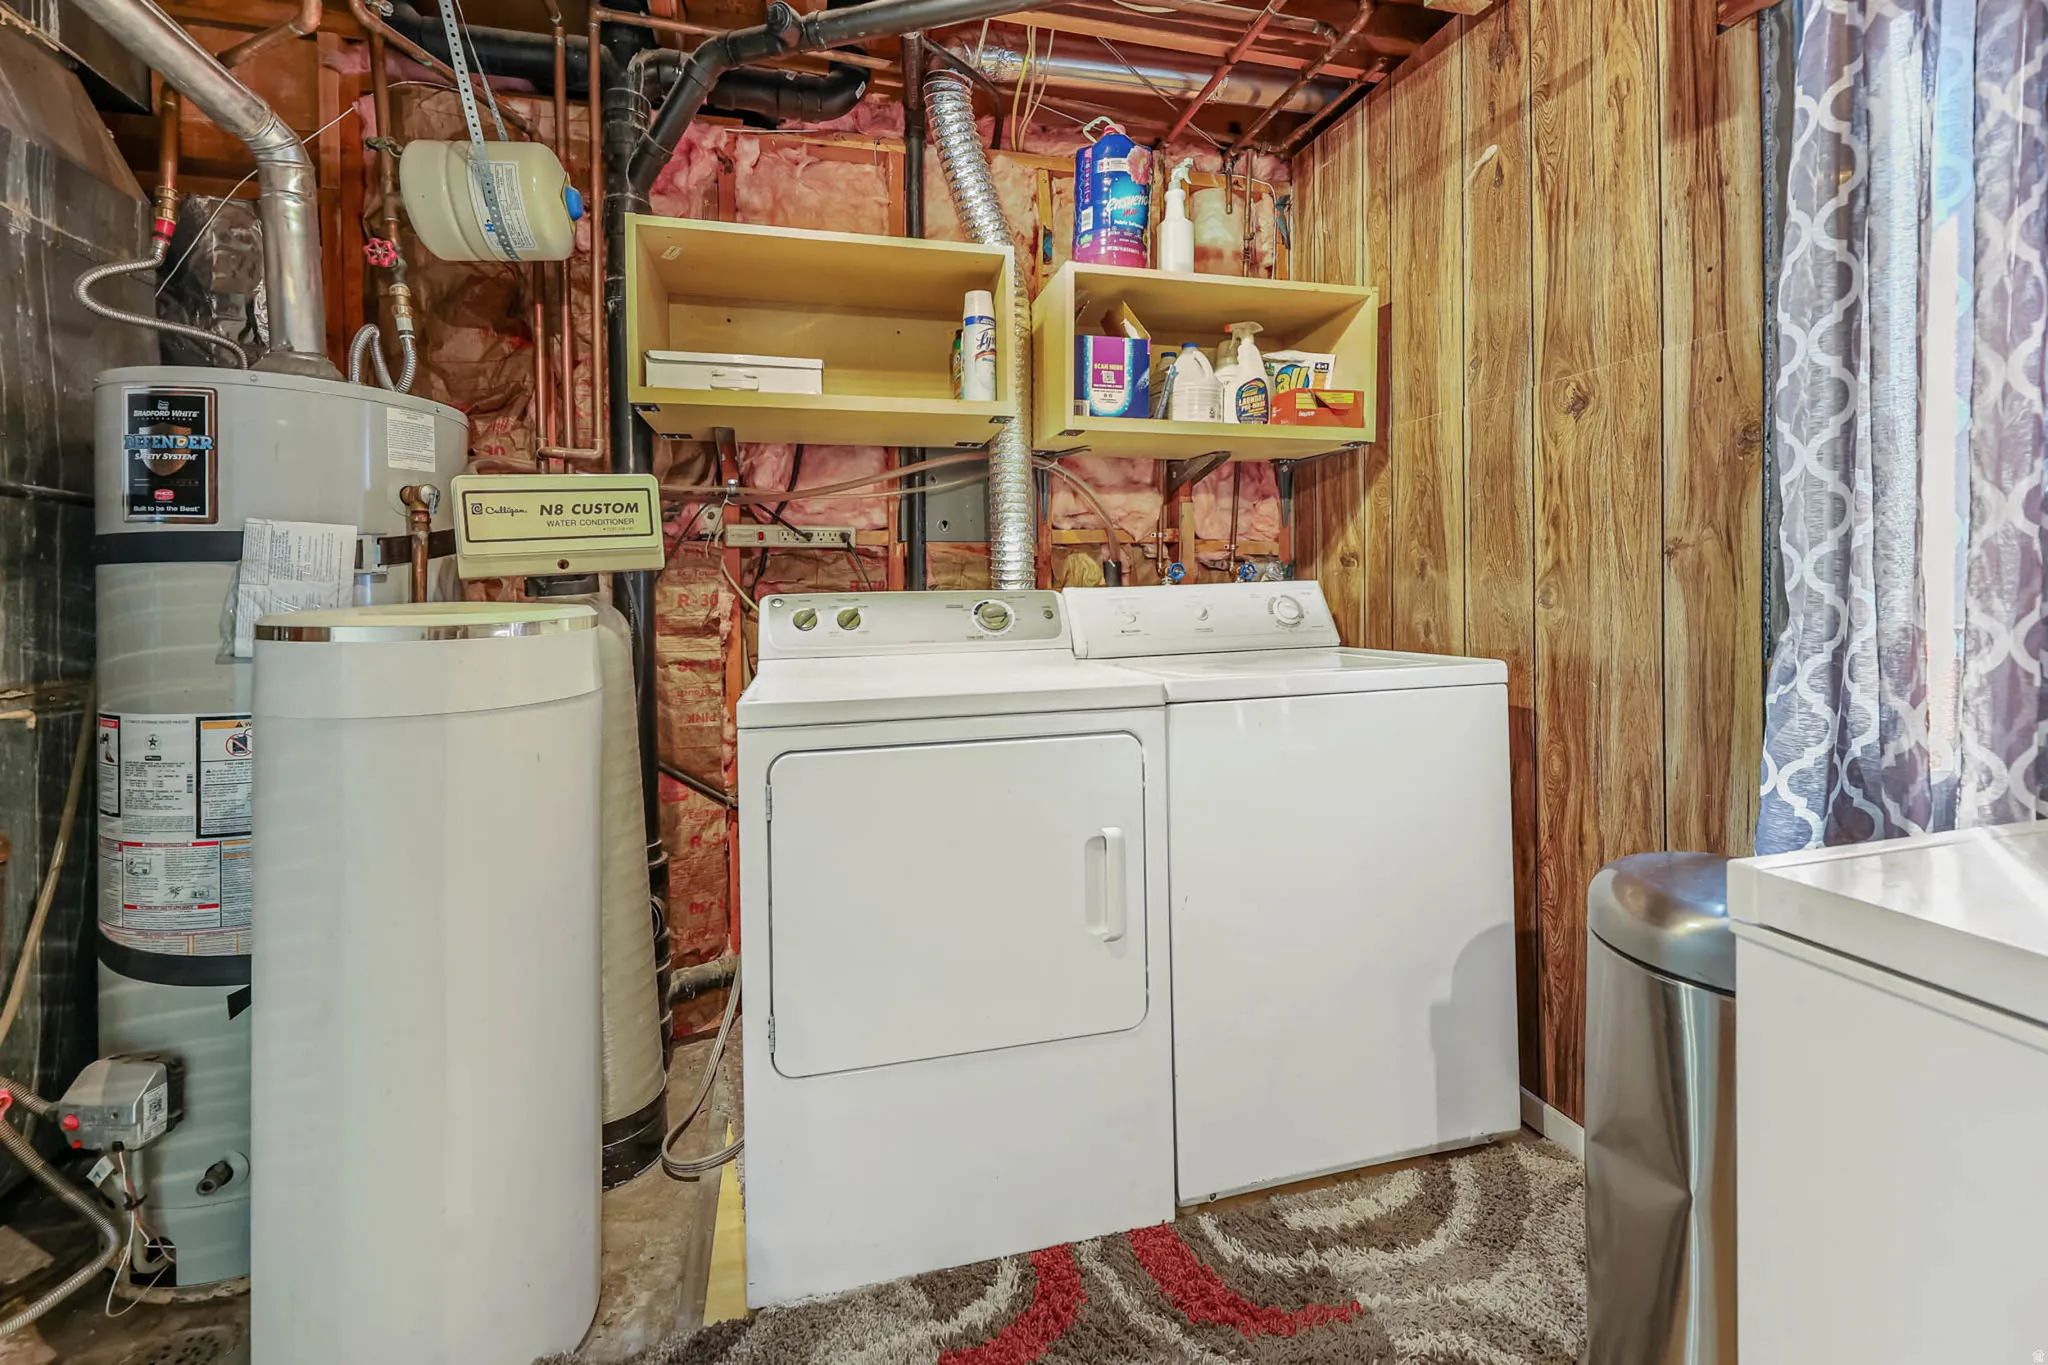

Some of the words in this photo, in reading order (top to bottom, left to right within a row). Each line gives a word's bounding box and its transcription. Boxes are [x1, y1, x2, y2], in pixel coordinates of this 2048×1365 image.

[1276, 367, 1310, 394] all
[124, 434, 214, 450] DEFENDER
[540, 503, 564, 516] N8
[571, 502, 639, 515] CUSTOM
[546, 519, 577, 527] WATER
[579, 518, 635, 526] CONDITIONER
[676, 592, 719, 608] R-30
